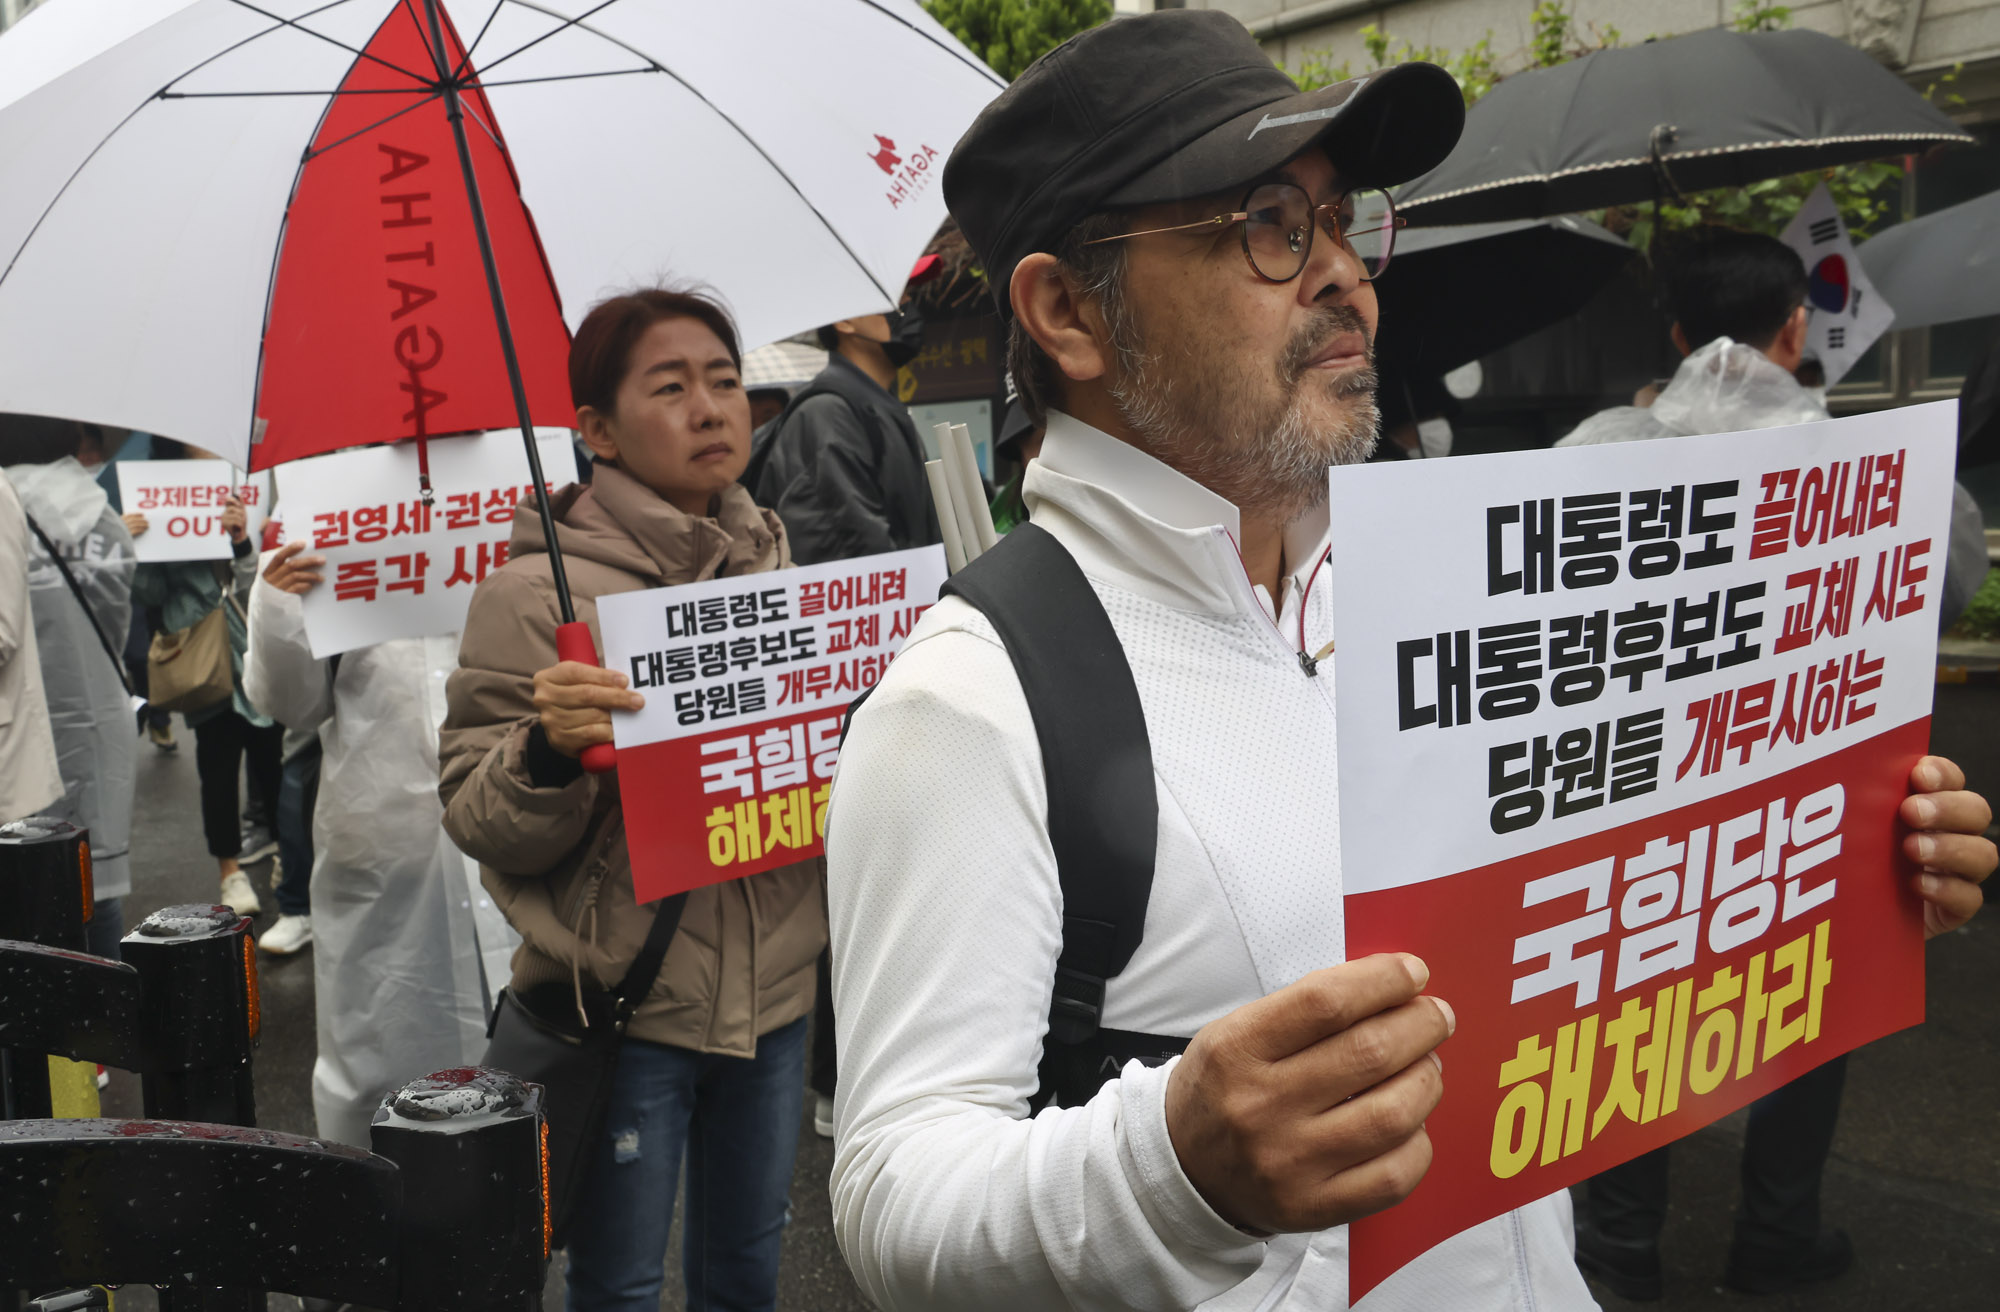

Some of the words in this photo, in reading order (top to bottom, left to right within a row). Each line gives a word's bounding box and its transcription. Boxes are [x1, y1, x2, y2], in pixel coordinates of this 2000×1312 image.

[334, 552, 430, 602] 즉각
[1486, 480, 1739, 596] 대통령도
[1748, 448, 1906, 560] 끌어내려
[630, 626, 817, 689] 대통령후보도
[826, 613, 880, 655] 교체
[665, 588, 790, 639] 대통령도
[799, 568, 907, 618] 끌어내려
[1397, 581, 1767, 731] 대통령후보도
[1773, 555, 1857, 655] 교체
[1862, 538, 1932, 626] 시도
[674, 677, 767, 726] 당원들
[777, 651, 895, 708] 개무시하
[1488, 708, 1664, 835] 당원들
[1675, 649, 1885, 783] 개무시하는
[1510, 783, 1845, 1009] 국힘당은
[1488, 919, 1832, 1179] 해체하라
